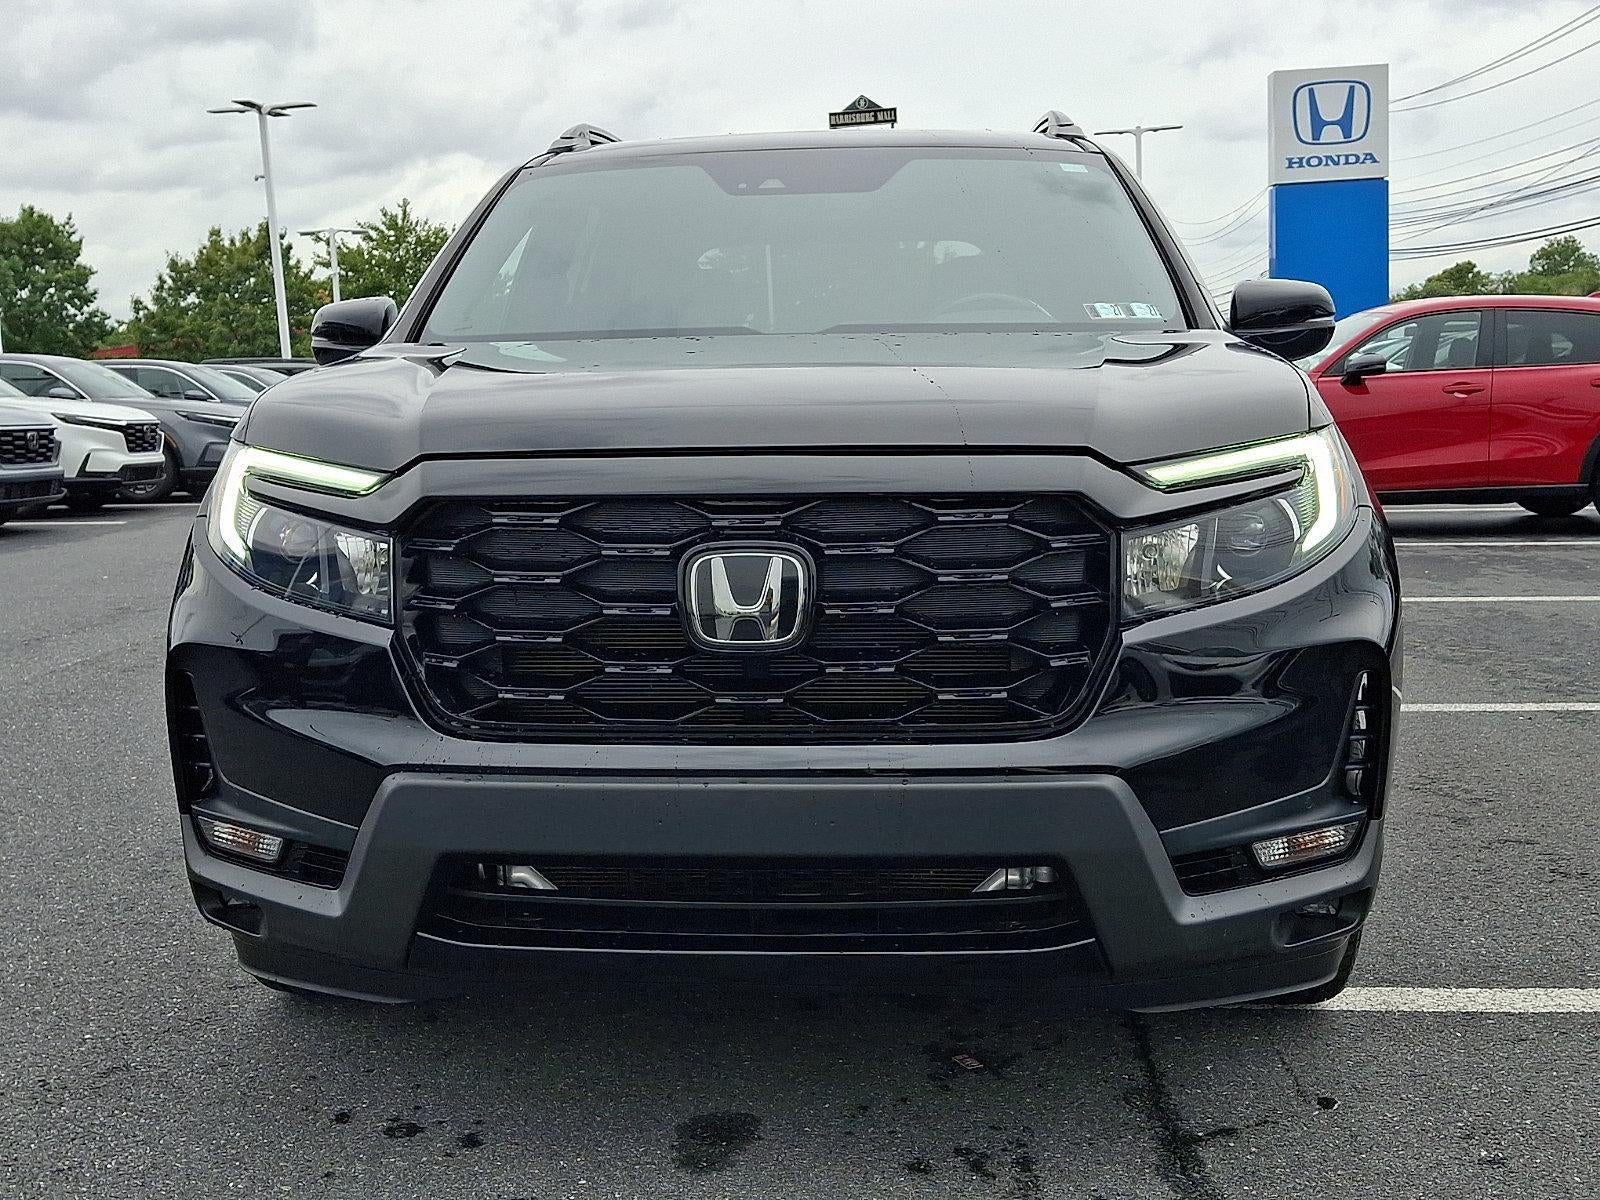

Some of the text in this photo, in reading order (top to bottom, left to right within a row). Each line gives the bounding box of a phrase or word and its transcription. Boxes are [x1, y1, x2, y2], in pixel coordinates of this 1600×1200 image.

[830, 110, 896, 125] HARRISBURG MALL
[1285, 152, 1380, 169] HONDA
